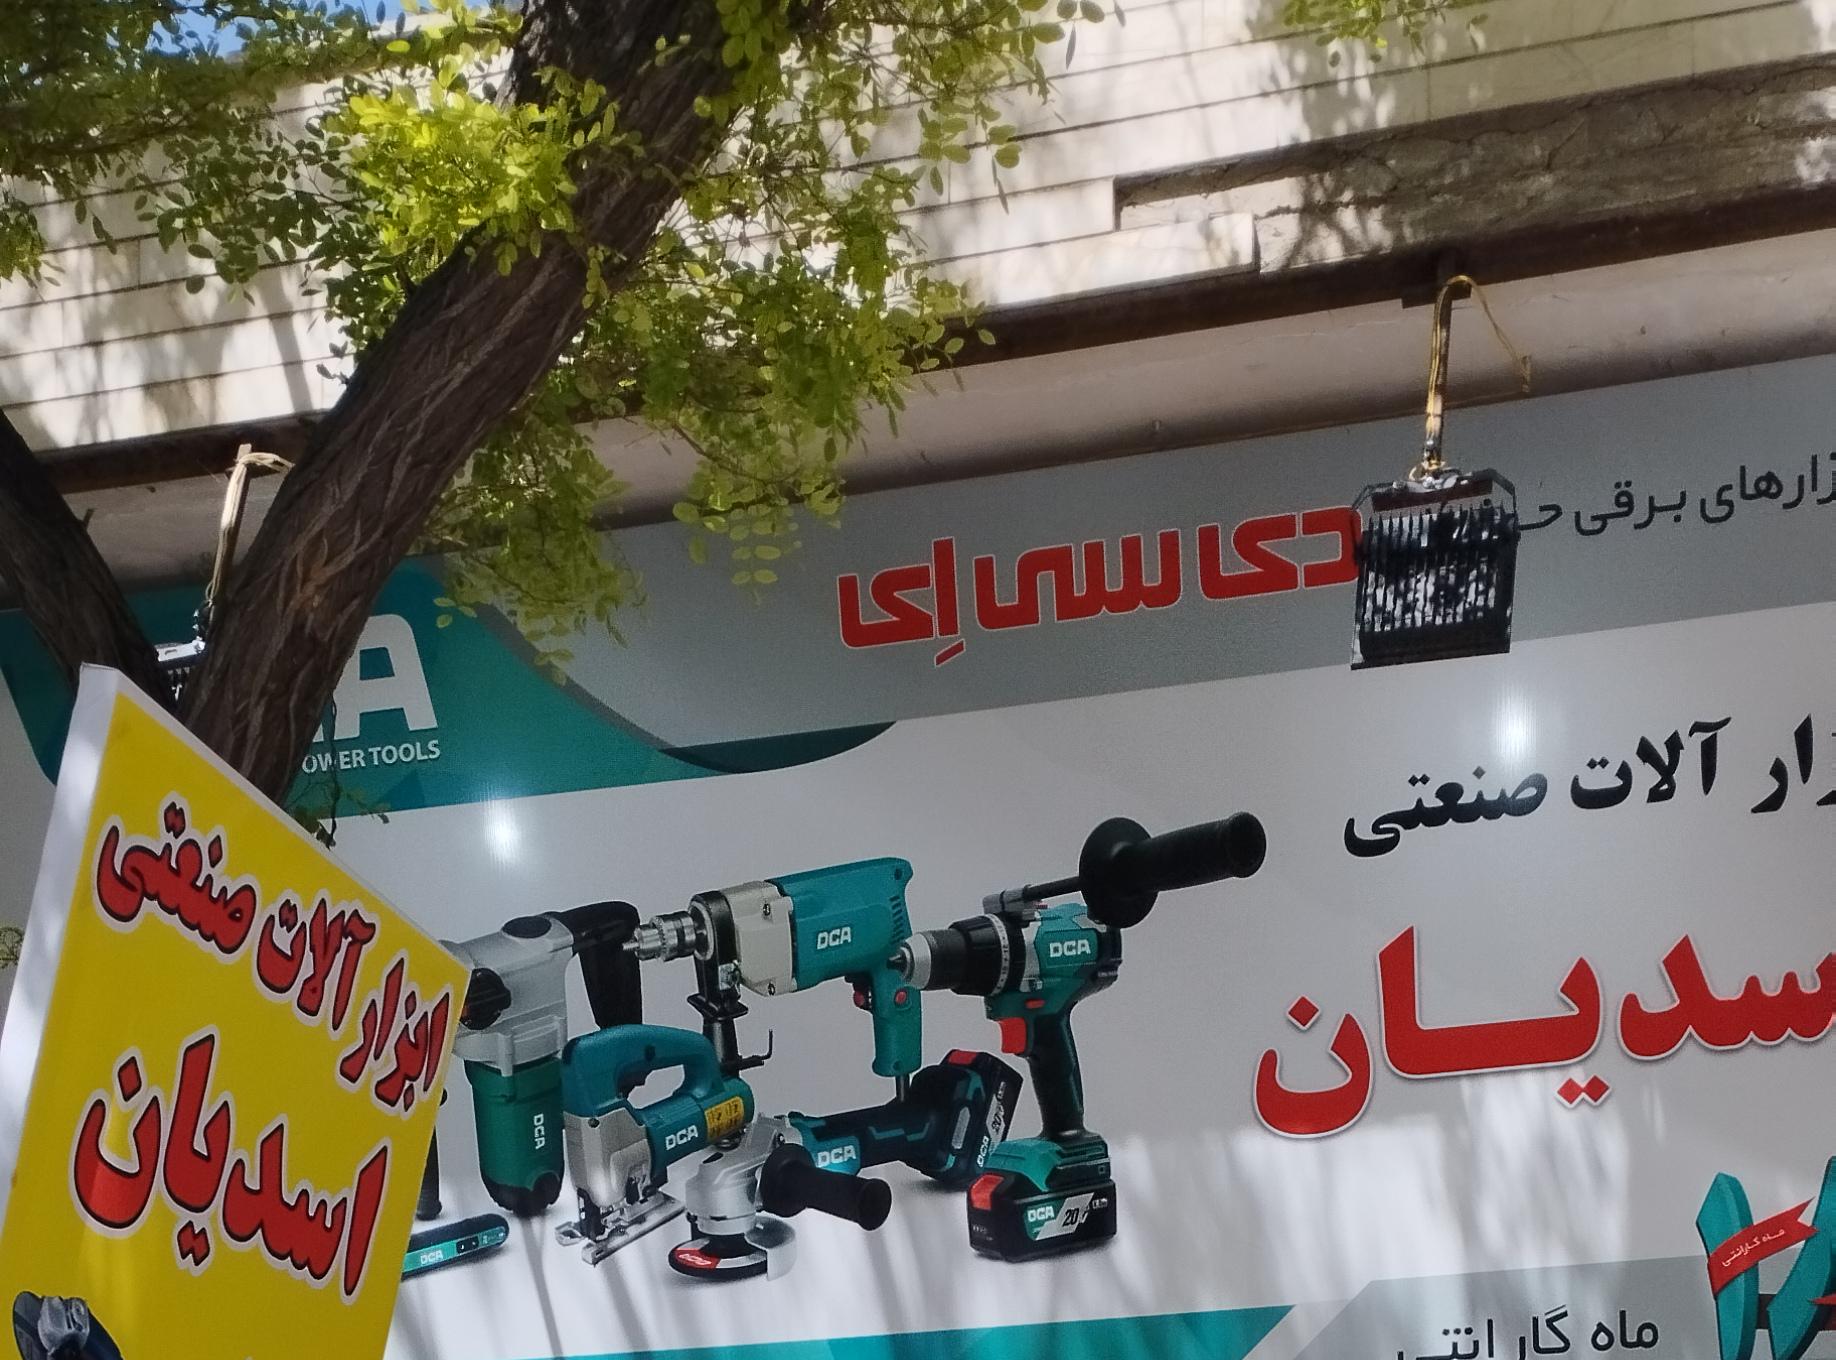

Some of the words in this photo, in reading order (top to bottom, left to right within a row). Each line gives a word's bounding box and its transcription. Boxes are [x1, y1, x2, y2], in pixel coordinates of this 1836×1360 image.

[1574, 478, 1687, 537] برقی
[975, 529, 1183, 632] سی
[1199, 504, 1362, 600] دی
[301, 749, 366, 774] OWER
[368, 740, 441, 766] TOOLS
[1570, 716, 1732, 810] آلات
[1343, 766, 1549, 858] صنعتی
[96, 800, 257, 955] صنعتی
[257, 897, 377, 1032] آلات
[817, 926, 853, 952] DCA
[1050, 936, 1091, 958] DCA
[339, 956, 450, 1110] ابزار
[1255, 925, 1836, 1137] سدیان
[534, 1113, 545, 1150] DCA
[665, 1124, 699, 1151] DCA
[817, 1144, 857, 1168] DCA
[74, 1034, 389, 1300] اسدیان
[1028, 1204, 1055, 1223] DCA
[419, 1250, 444, 1267] DCA
[1590, 1306, 1660, 1354] ماه
